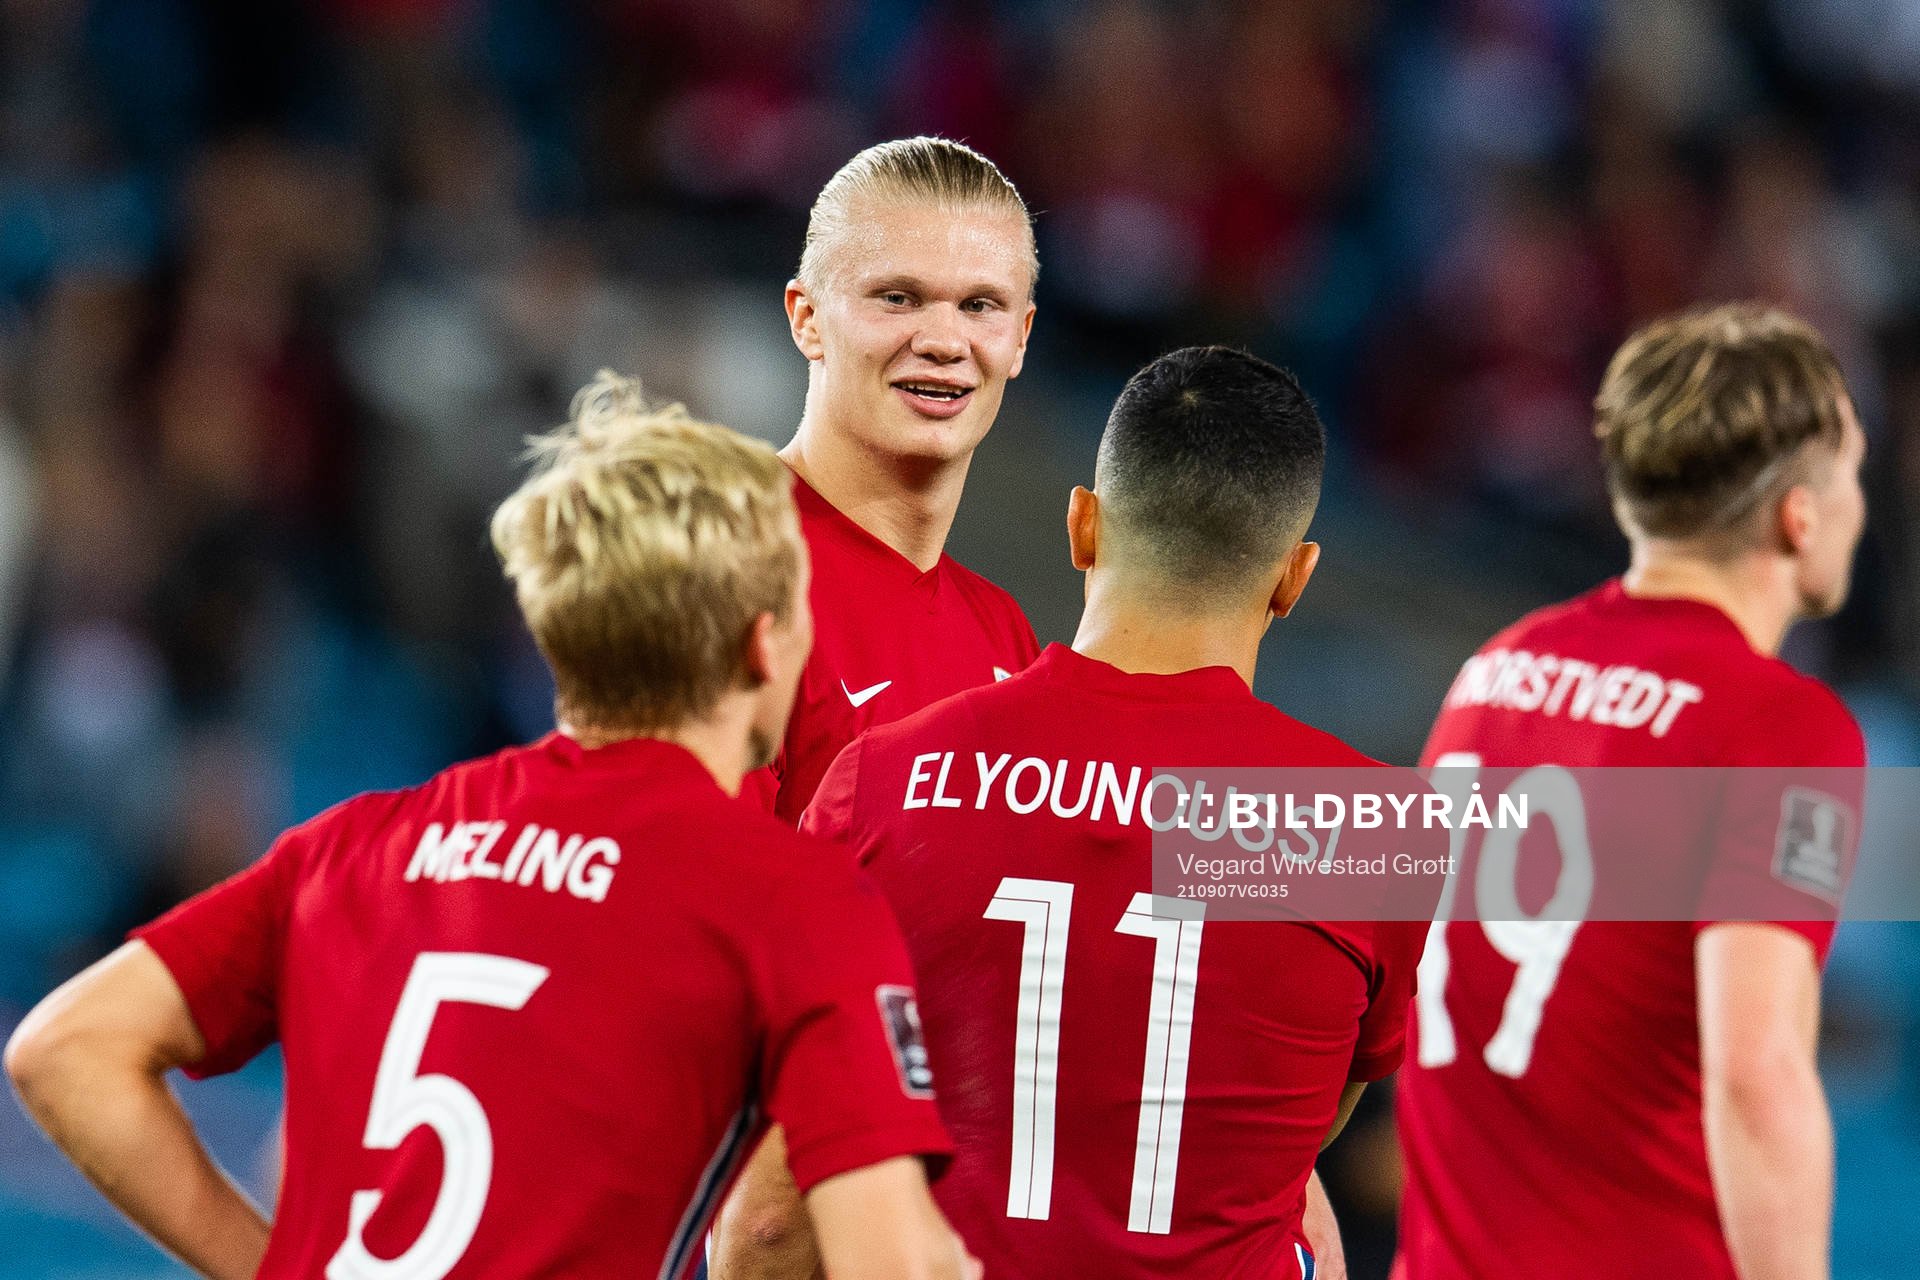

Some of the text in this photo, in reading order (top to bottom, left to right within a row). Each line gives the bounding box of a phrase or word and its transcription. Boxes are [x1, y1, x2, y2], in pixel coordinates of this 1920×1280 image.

[404, 819, 622, 903] MELING
[1414, 752, 1595, 1080] 19
[324, 951, 551, 1280] 5
[982, 876, 1208, 1235] 11
